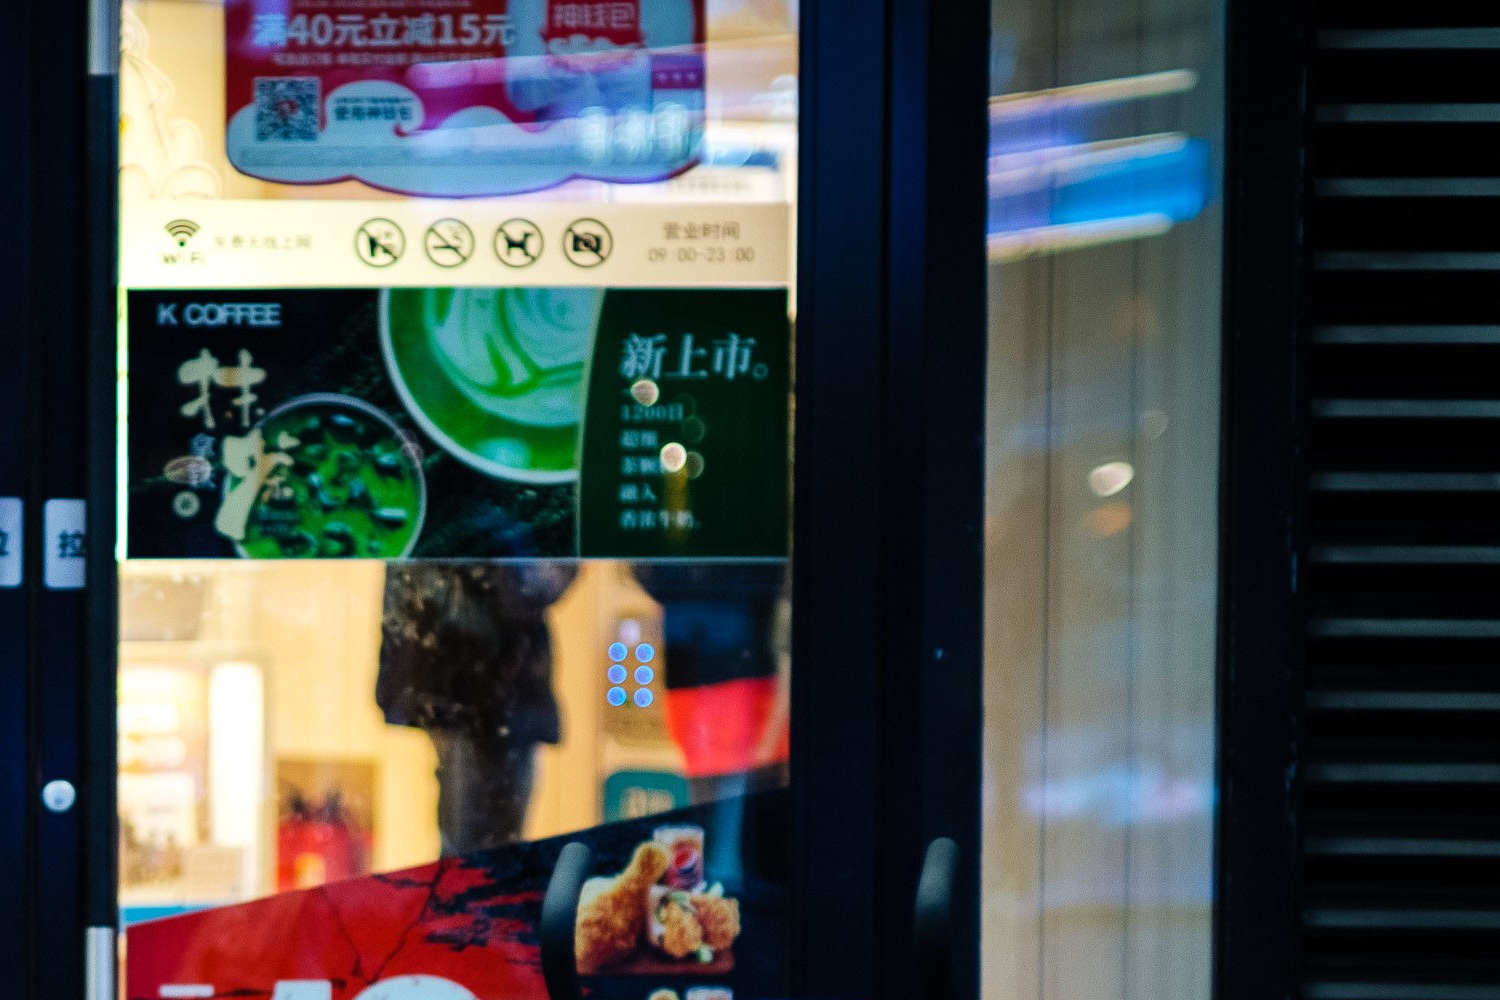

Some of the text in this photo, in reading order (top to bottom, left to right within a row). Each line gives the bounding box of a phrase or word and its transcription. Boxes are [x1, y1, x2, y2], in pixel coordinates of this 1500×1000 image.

[253, 13, 517, 46] 满40元立减15元
[663, 221, 741, 240] 营业时间
[156, 303, 282, 326] K COFFEE
